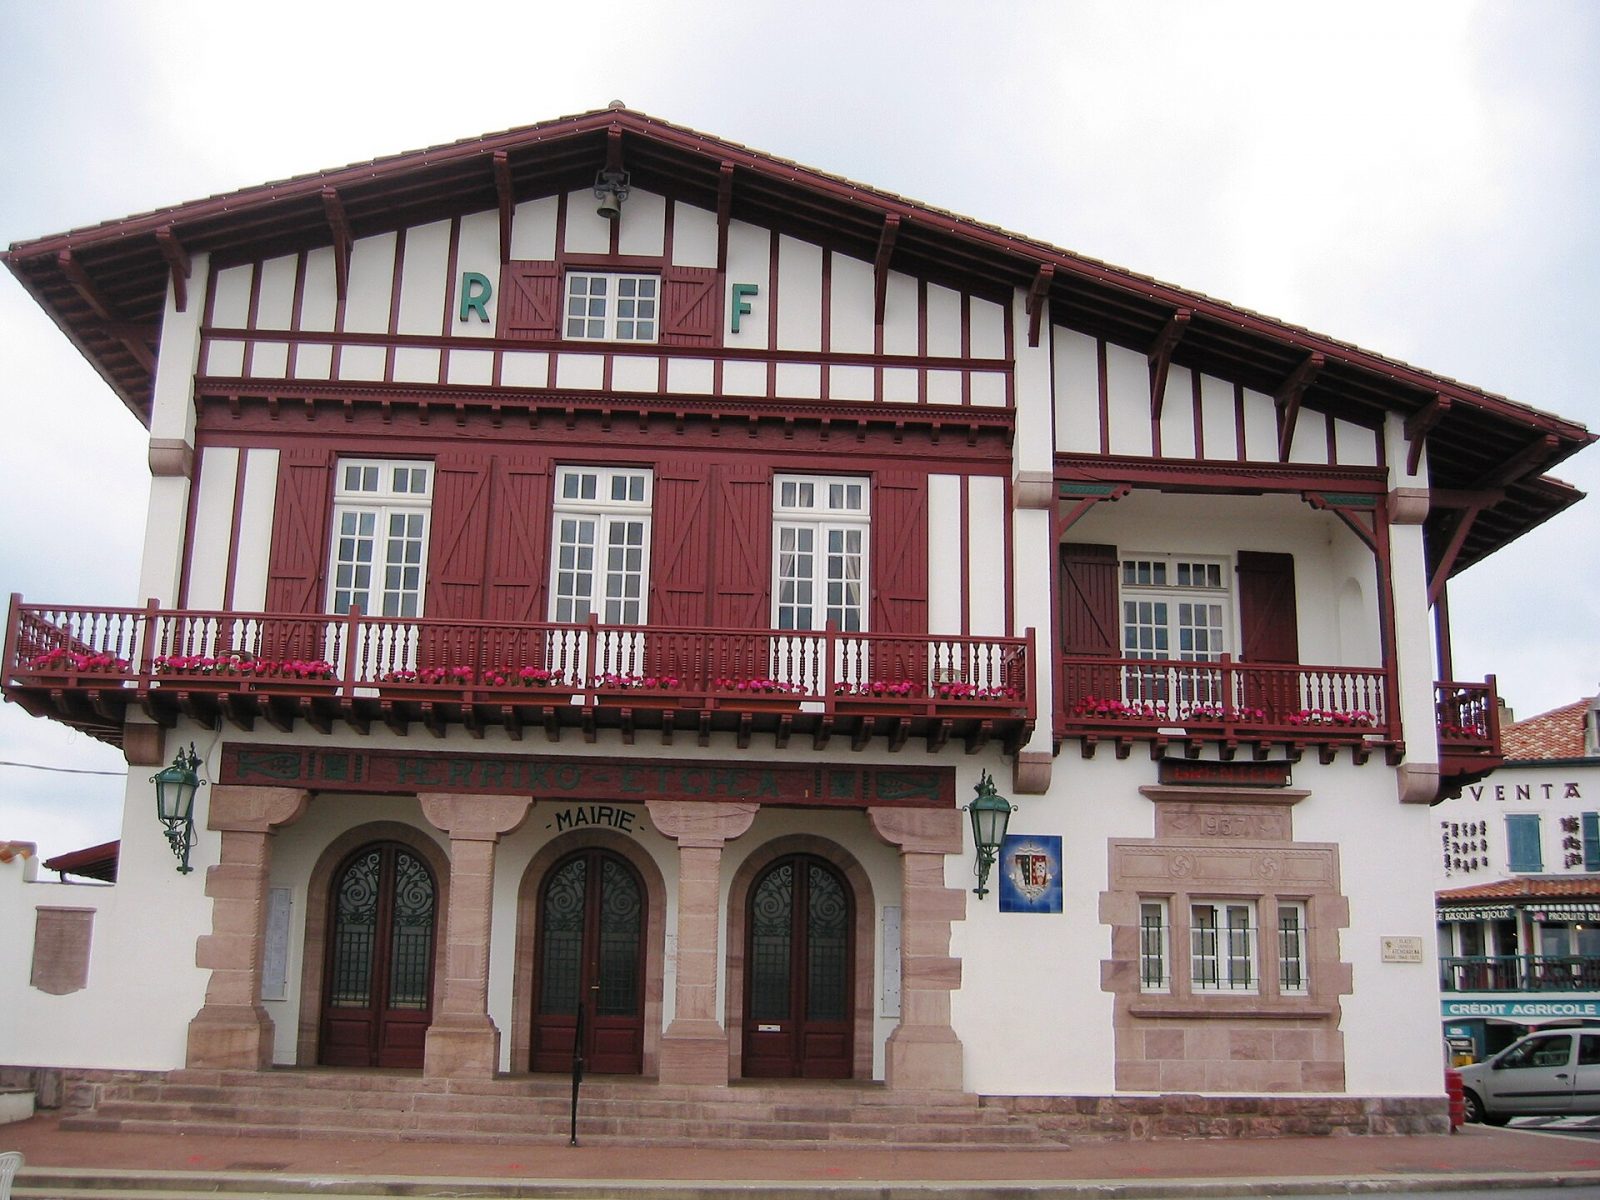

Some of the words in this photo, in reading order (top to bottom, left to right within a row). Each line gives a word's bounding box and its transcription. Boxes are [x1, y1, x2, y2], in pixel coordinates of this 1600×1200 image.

[459, 272, 492, 323] R
[731, 283, 759, 334] F
[1469, 782, 1581, 801] VENTA
[555, 806, 636, 833] MAIRIE
[1445, 911, 1477, 921] BASQUE
[1548, 912, 1586, 921] PRODUITS
[1449, 1002, 1506, 1015] CRÉDIT
[1511, 1003, 1597, 1015] AGRICOLE
